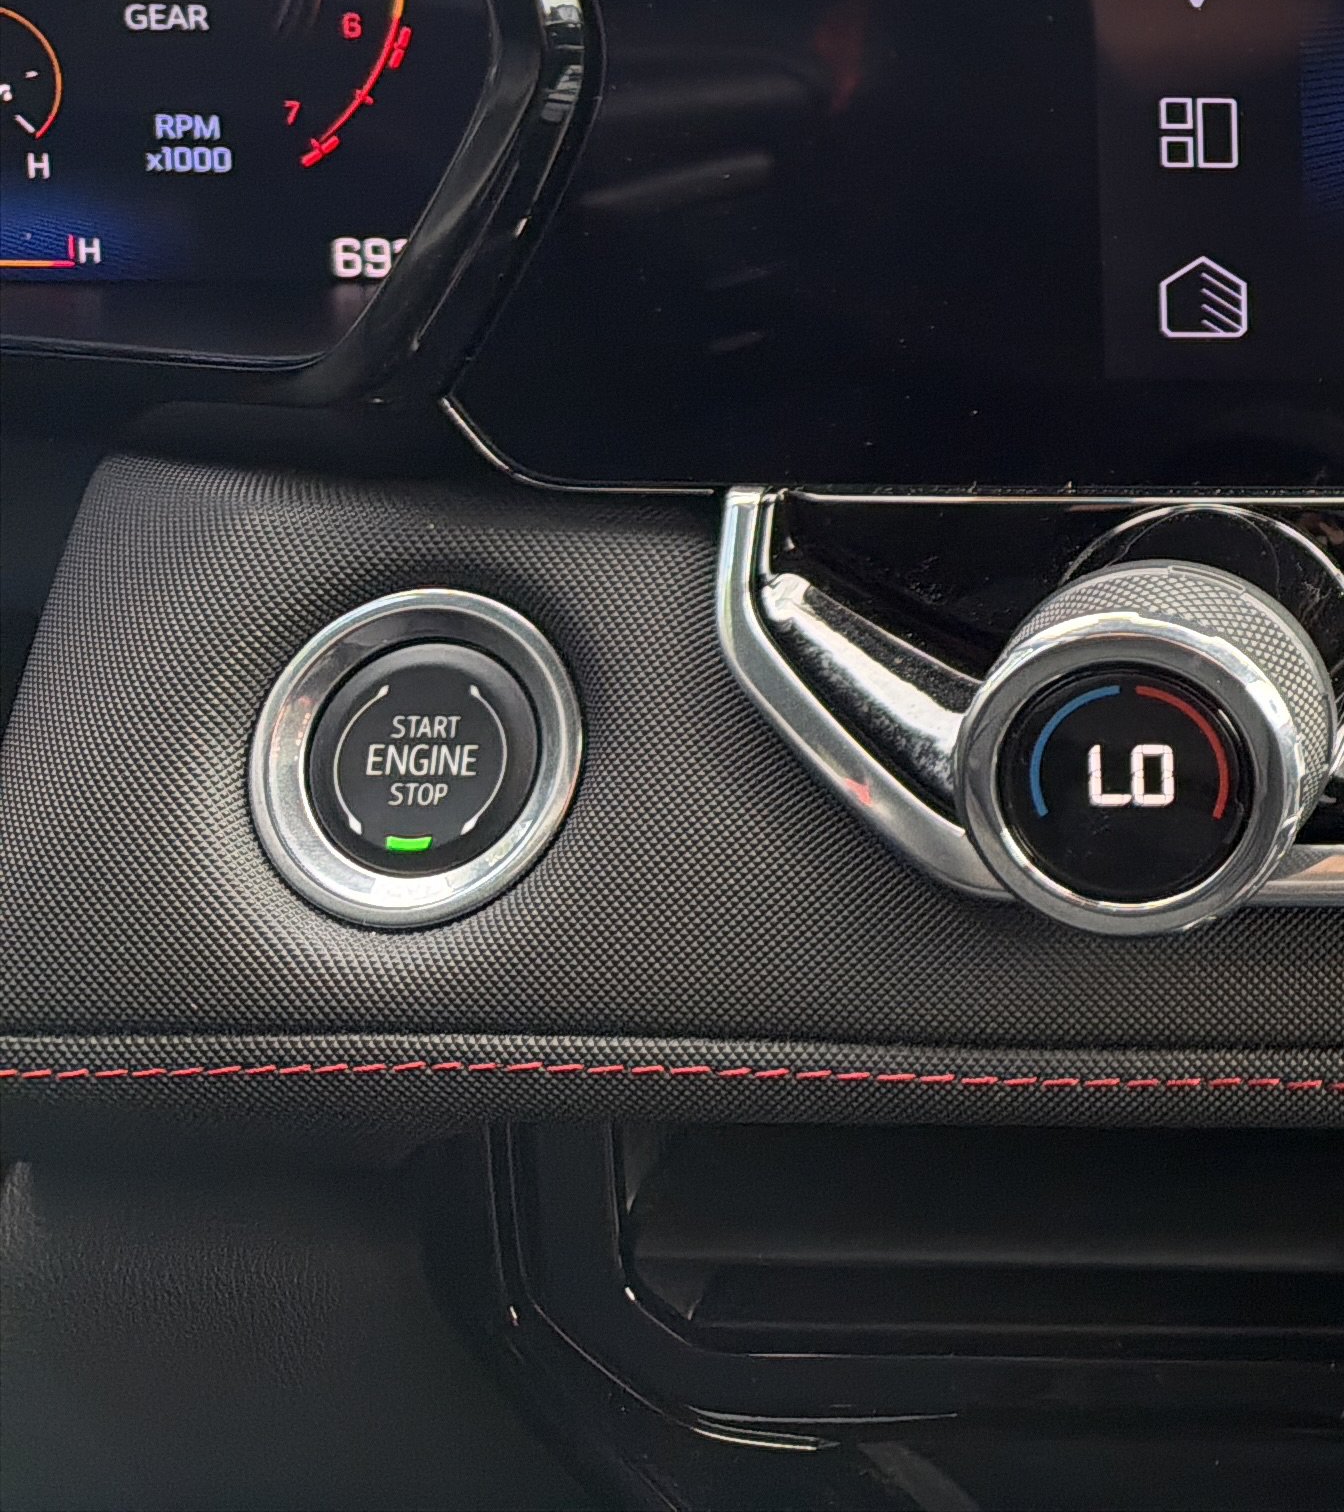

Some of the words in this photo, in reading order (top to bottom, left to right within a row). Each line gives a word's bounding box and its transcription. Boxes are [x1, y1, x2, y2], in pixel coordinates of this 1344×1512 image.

[125, 3, 209, 31] GEAR
[342, 12, 362, 38] 6
[155, 114, 220, 138] RPM
[284, 100, 301, 125] 7
[27, 152, 50, 179] H
[147, 146, 232, 173] x1000
[78, 237, 101, 264] H
[390, 715, 461, 739] START
[365, 743, 479, 776] ENGINE
[1088, 743, 1175, 807] LO
[388, 782, 448, 806] STOP
